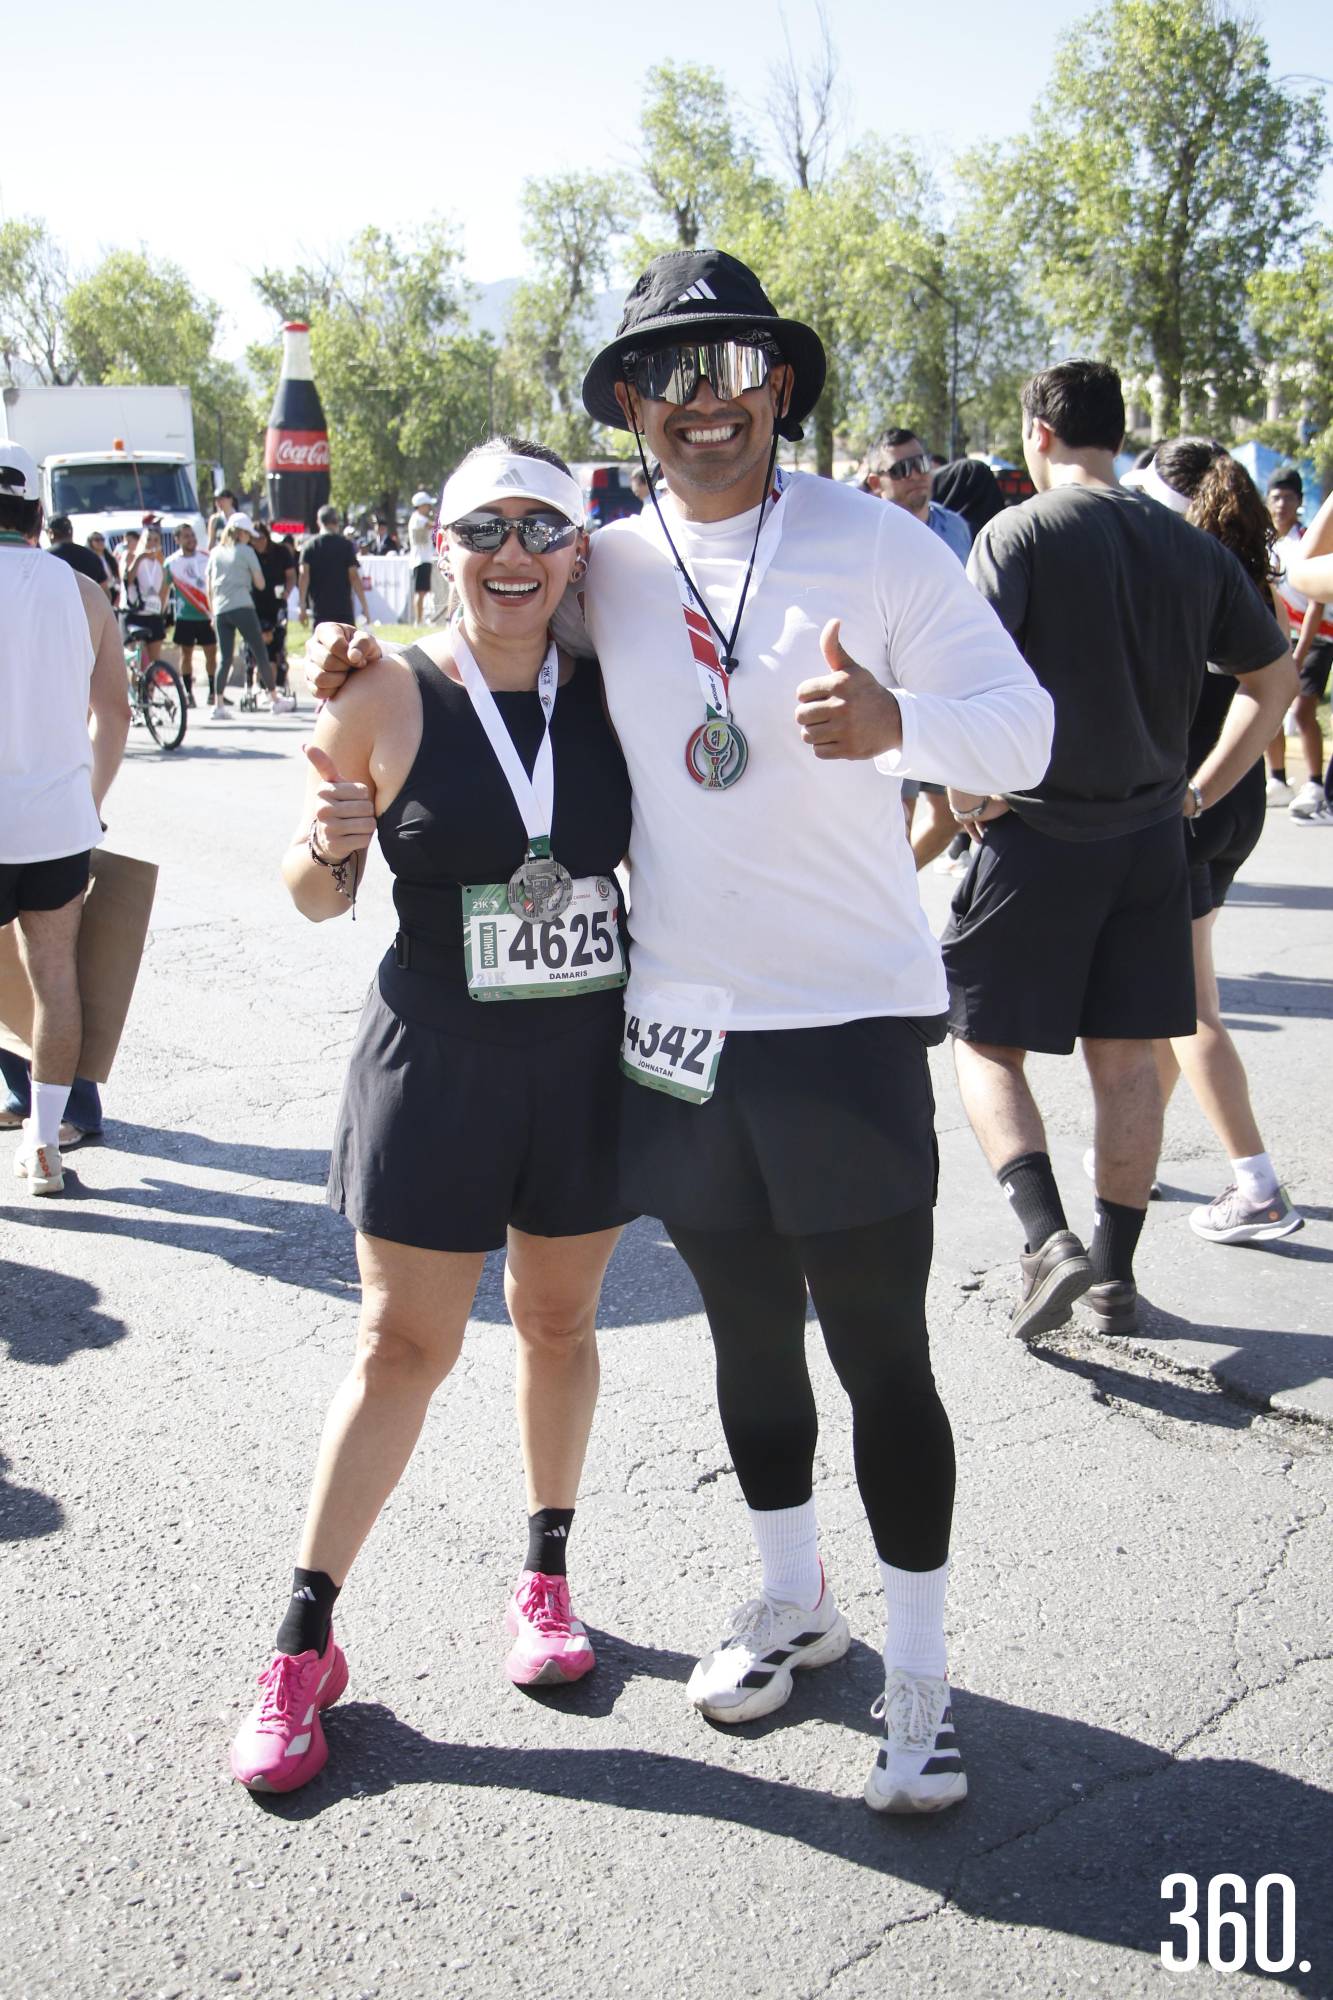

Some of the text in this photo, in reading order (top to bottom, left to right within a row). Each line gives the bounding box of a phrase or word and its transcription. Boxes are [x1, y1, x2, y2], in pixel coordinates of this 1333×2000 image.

[473, 900, 488, 909] 21K
[484, 924, 494, 967] COAHUILA
[508, 910, 614, 970] 4625
[549, 970, 588, 980] DAMARIS
[626, 1015, 712, 1075] 4342
[638, 1060, 674, 1078] JOHNATAN
